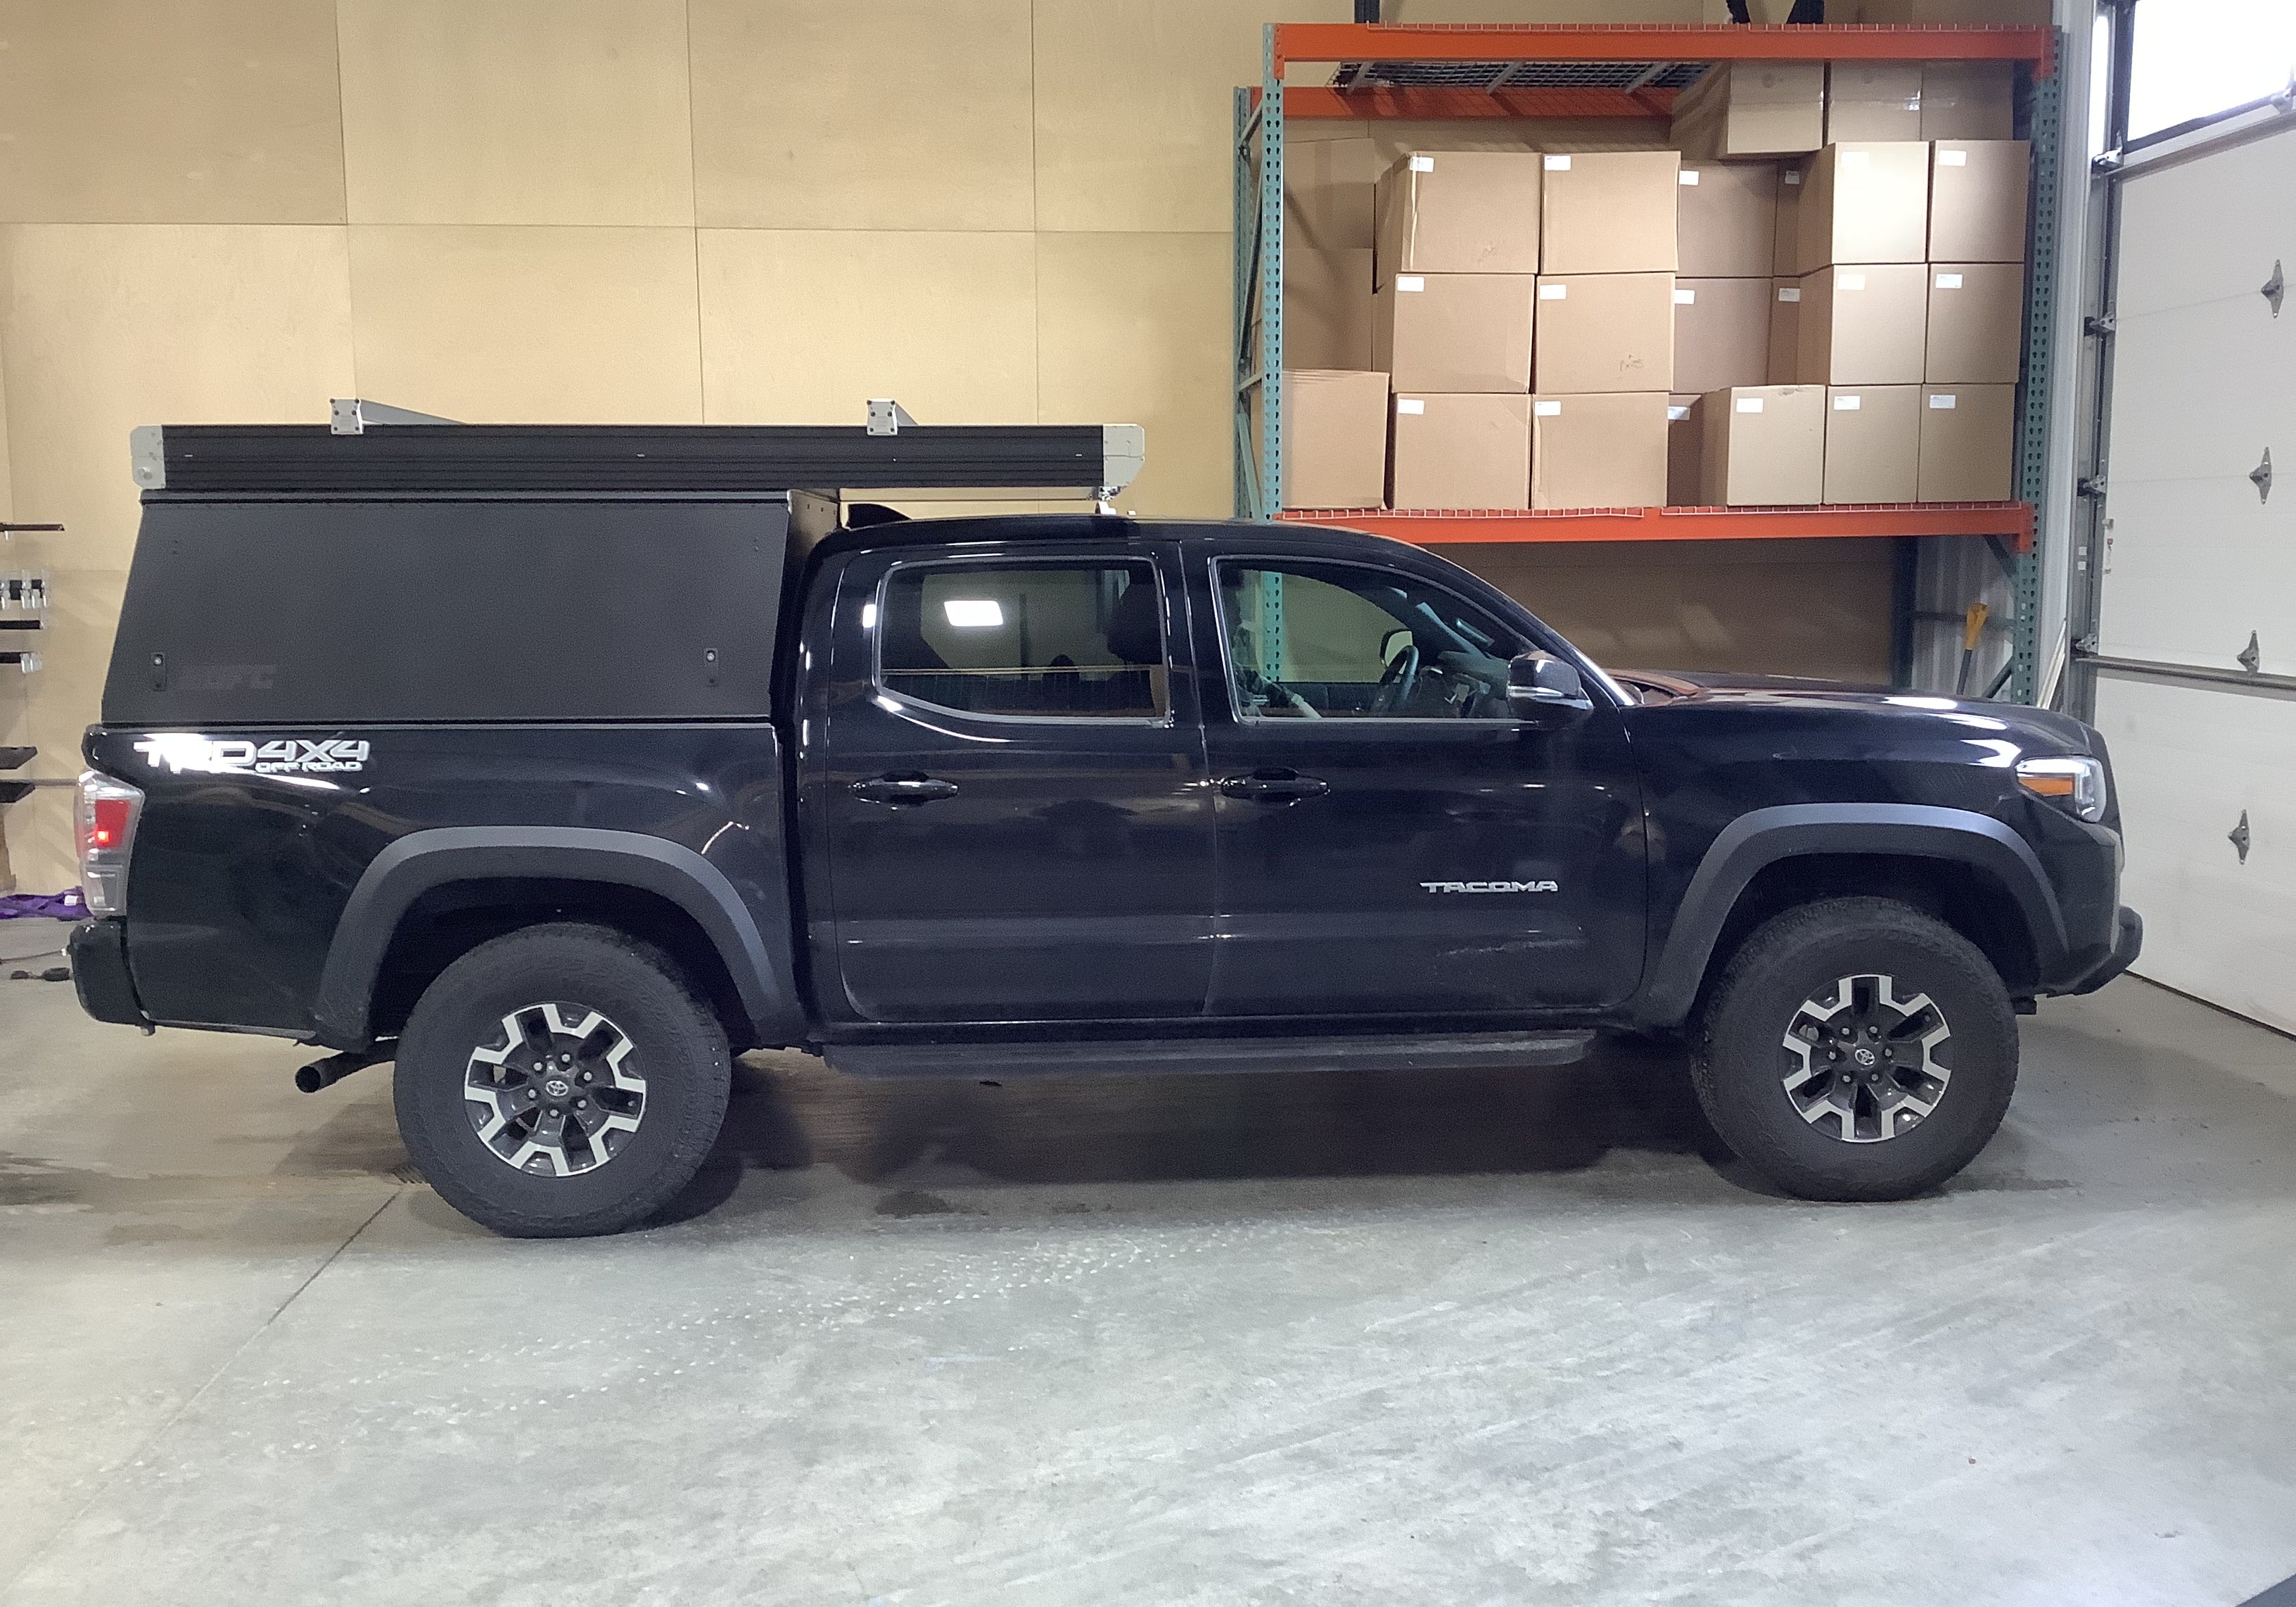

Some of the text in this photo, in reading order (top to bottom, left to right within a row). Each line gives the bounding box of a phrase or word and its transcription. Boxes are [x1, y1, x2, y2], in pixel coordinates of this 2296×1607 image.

[255, 761, 363, 773] OFF ROAD
[1420, 881, 1559, 893] TACOMA
